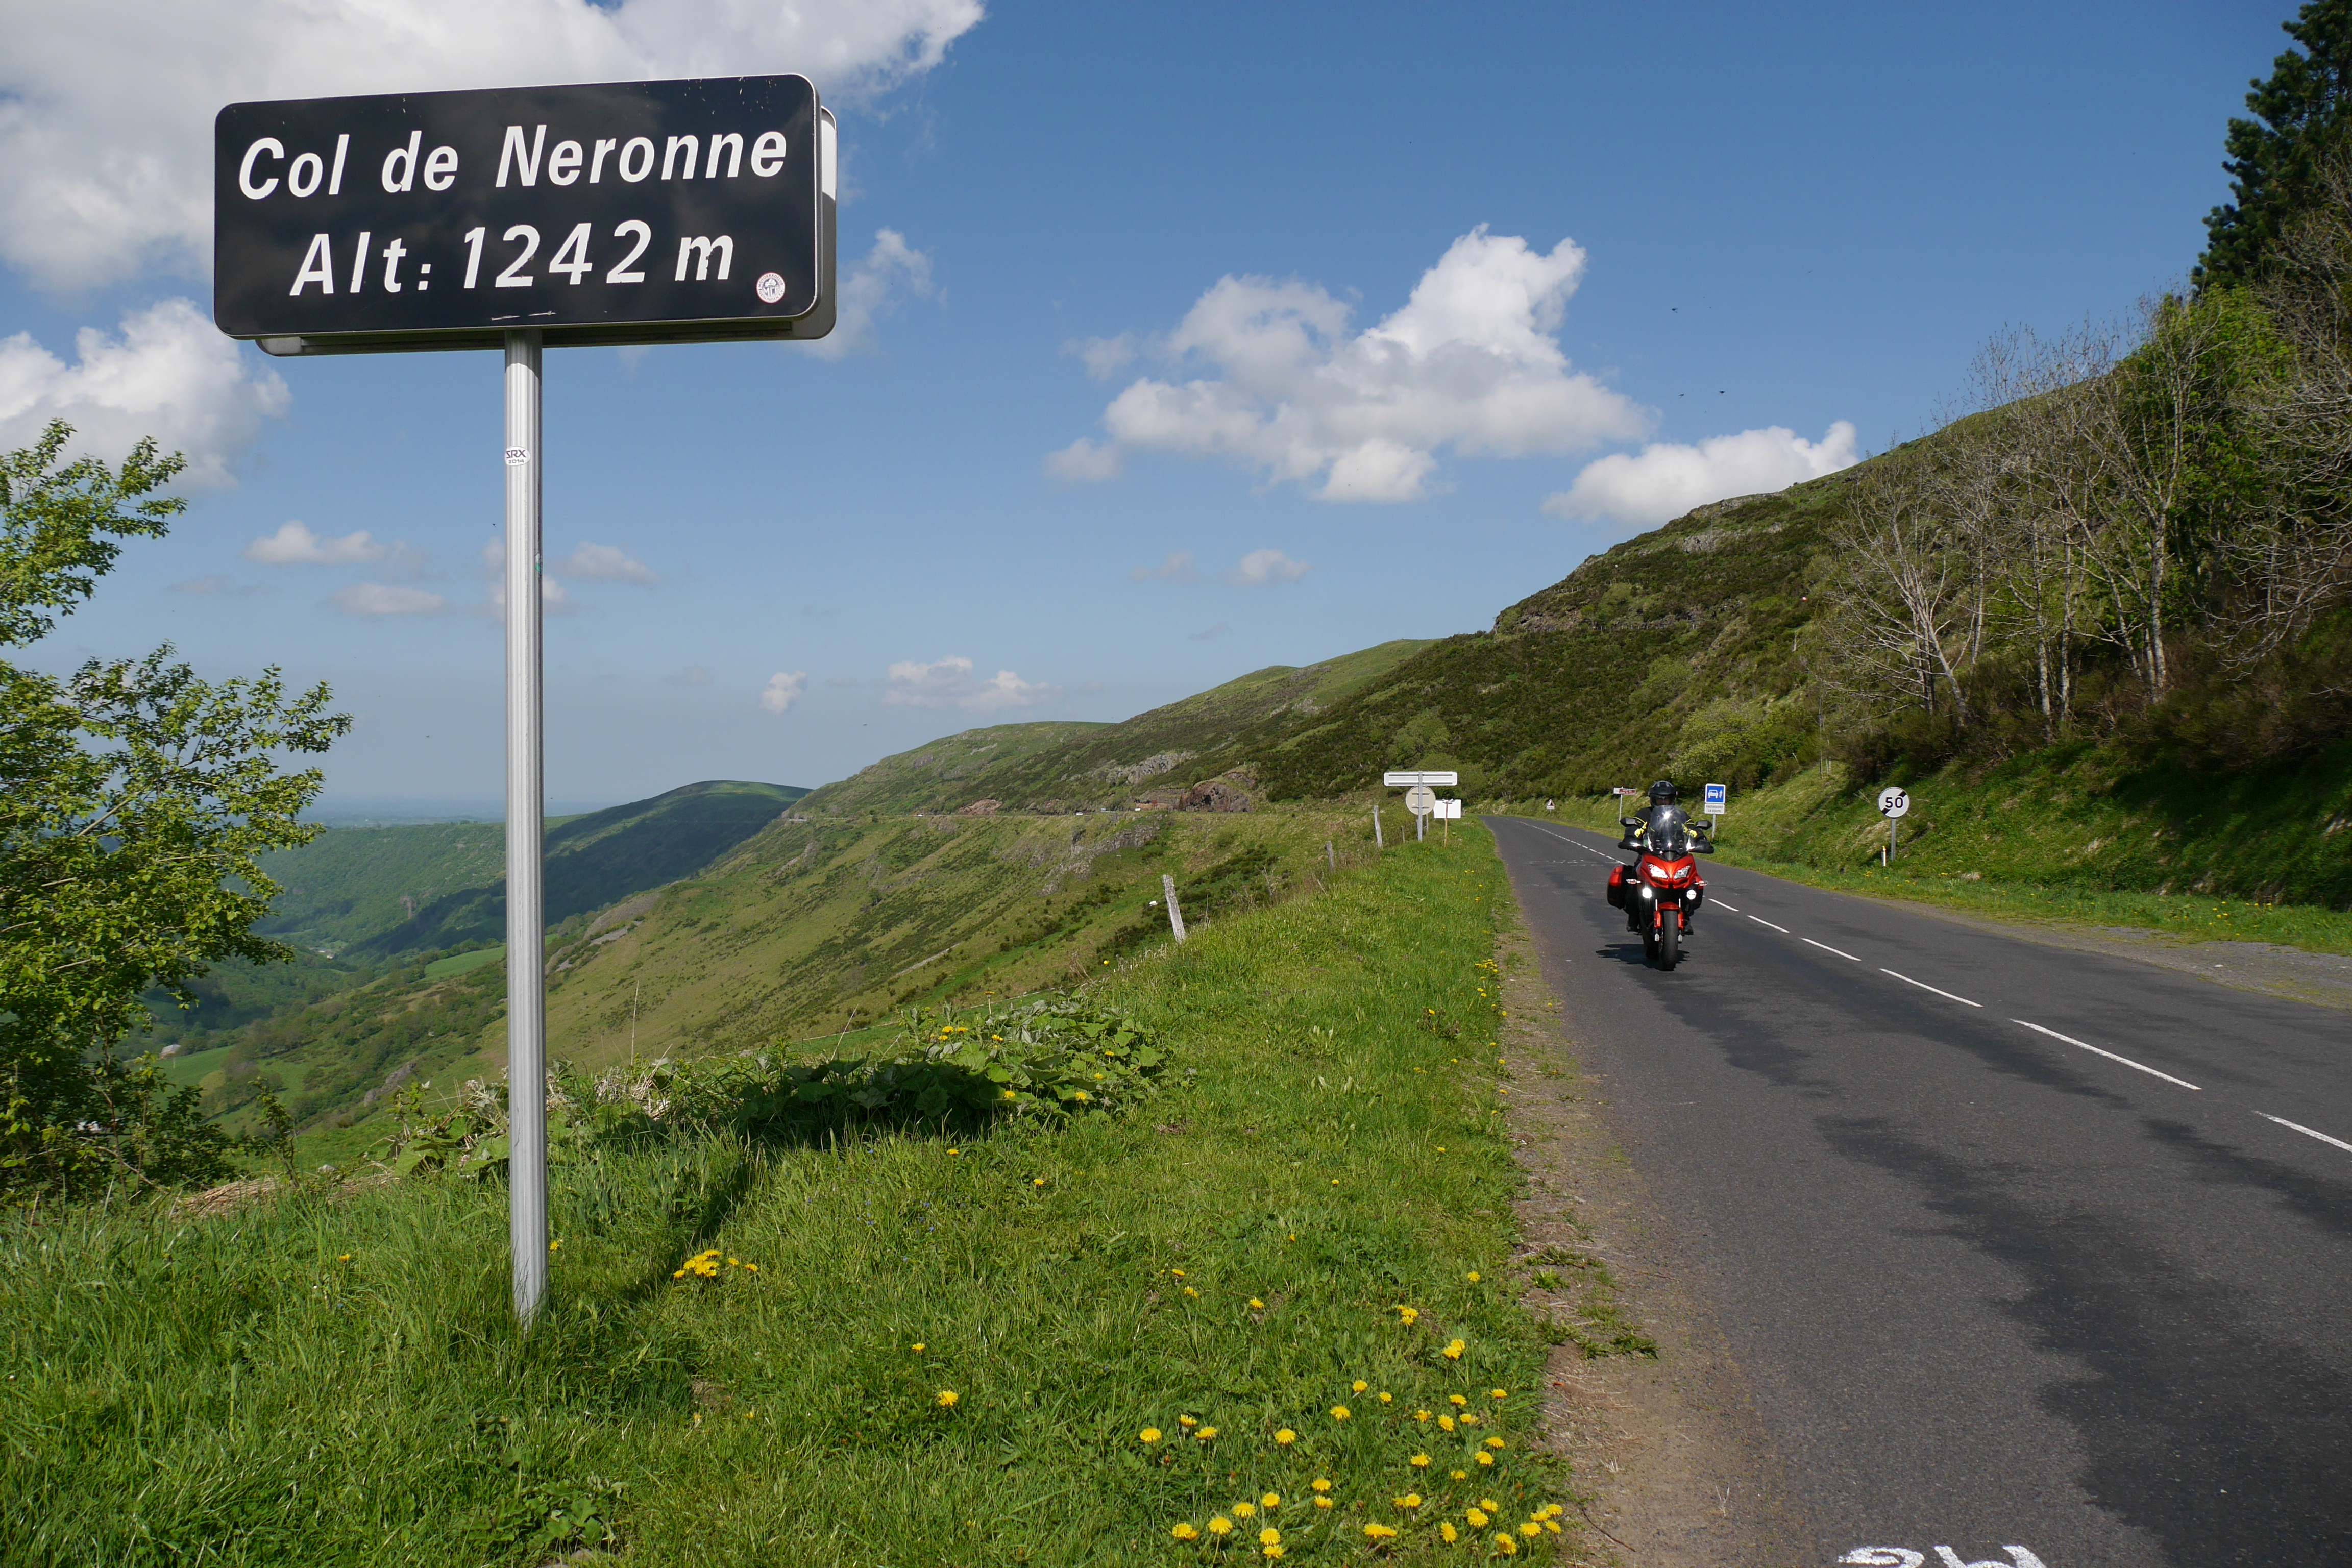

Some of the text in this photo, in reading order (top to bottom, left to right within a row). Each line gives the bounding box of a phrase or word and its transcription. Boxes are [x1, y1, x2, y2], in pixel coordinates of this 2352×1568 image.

[239, 124, 787, 200] Col de Neronne
[289, 219, 733, 296] Alt: 1242 m
[506, 449, 526, 458] SRX
[1885, 797, 1903, 808] 50
